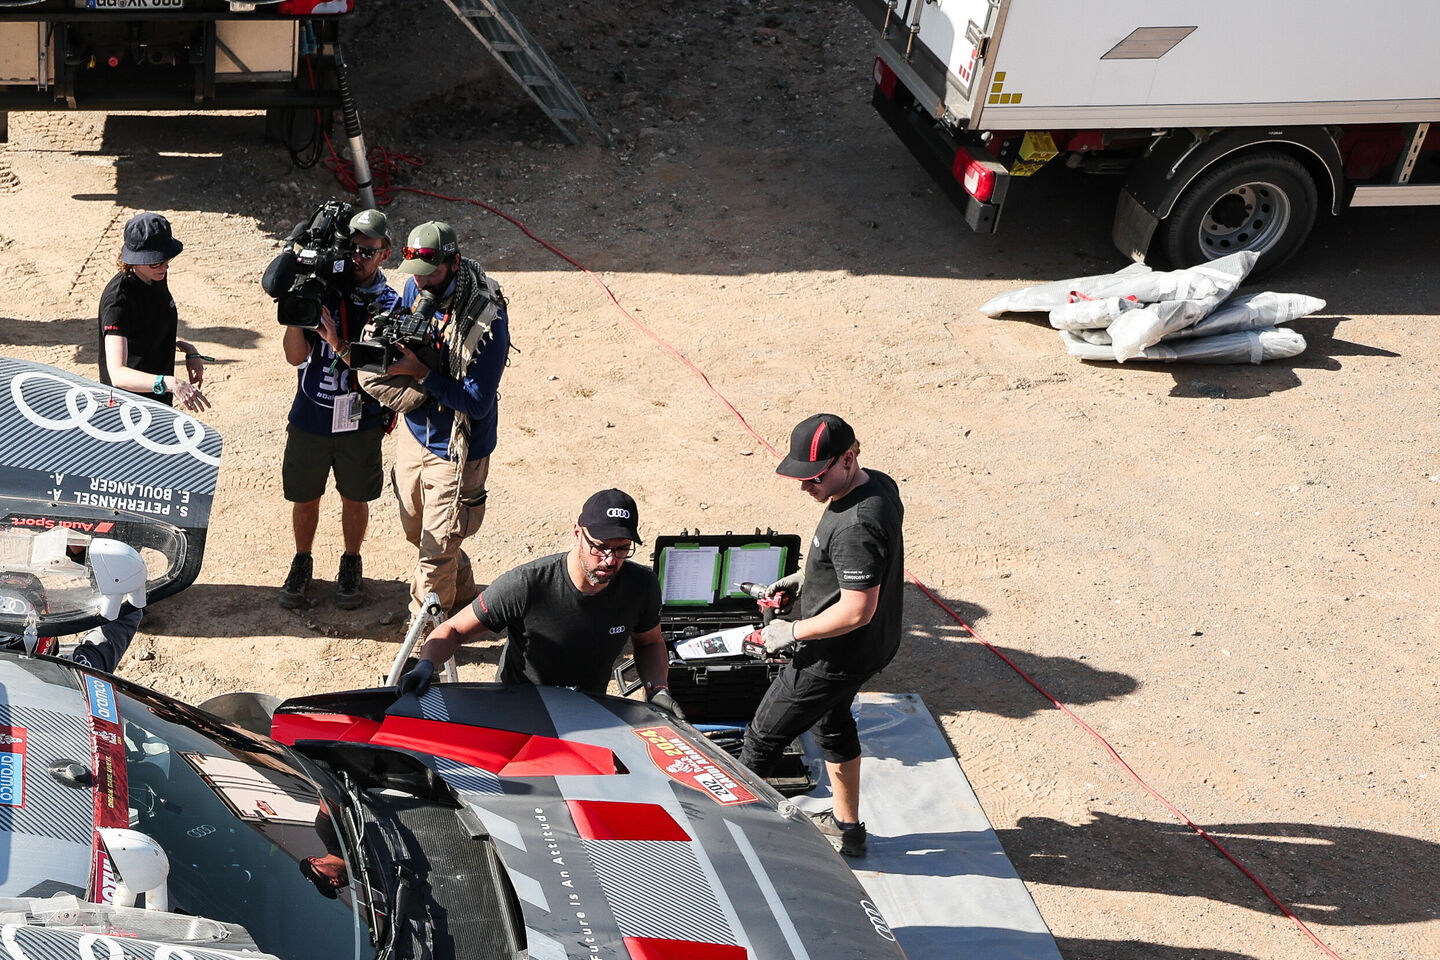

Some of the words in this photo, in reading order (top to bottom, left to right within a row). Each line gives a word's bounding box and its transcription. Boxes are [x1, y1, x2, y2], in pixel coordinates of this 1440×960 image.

[90, 477, 173, 501] BOULANGER
[177, 491, 190, 503] E.
[73, 491, 171, 516] PETERHANSEL
[175, 505, 189, 517] S.
[11, 517, 54, 529] Sport
[93, 680, 110, 718] aramco
[640, 729, 684, 757] 2024
[668, 737, 710, 765] ARABIA
[0, 755, 14, 801] aramco
[702, 778, 729, 797] 202
[703, 765, 738, 789] SAUDI
[534, 807, 565, 865] Attitude
[560, 871, 574, 888] An
[569, 893, 581, 906] Is
